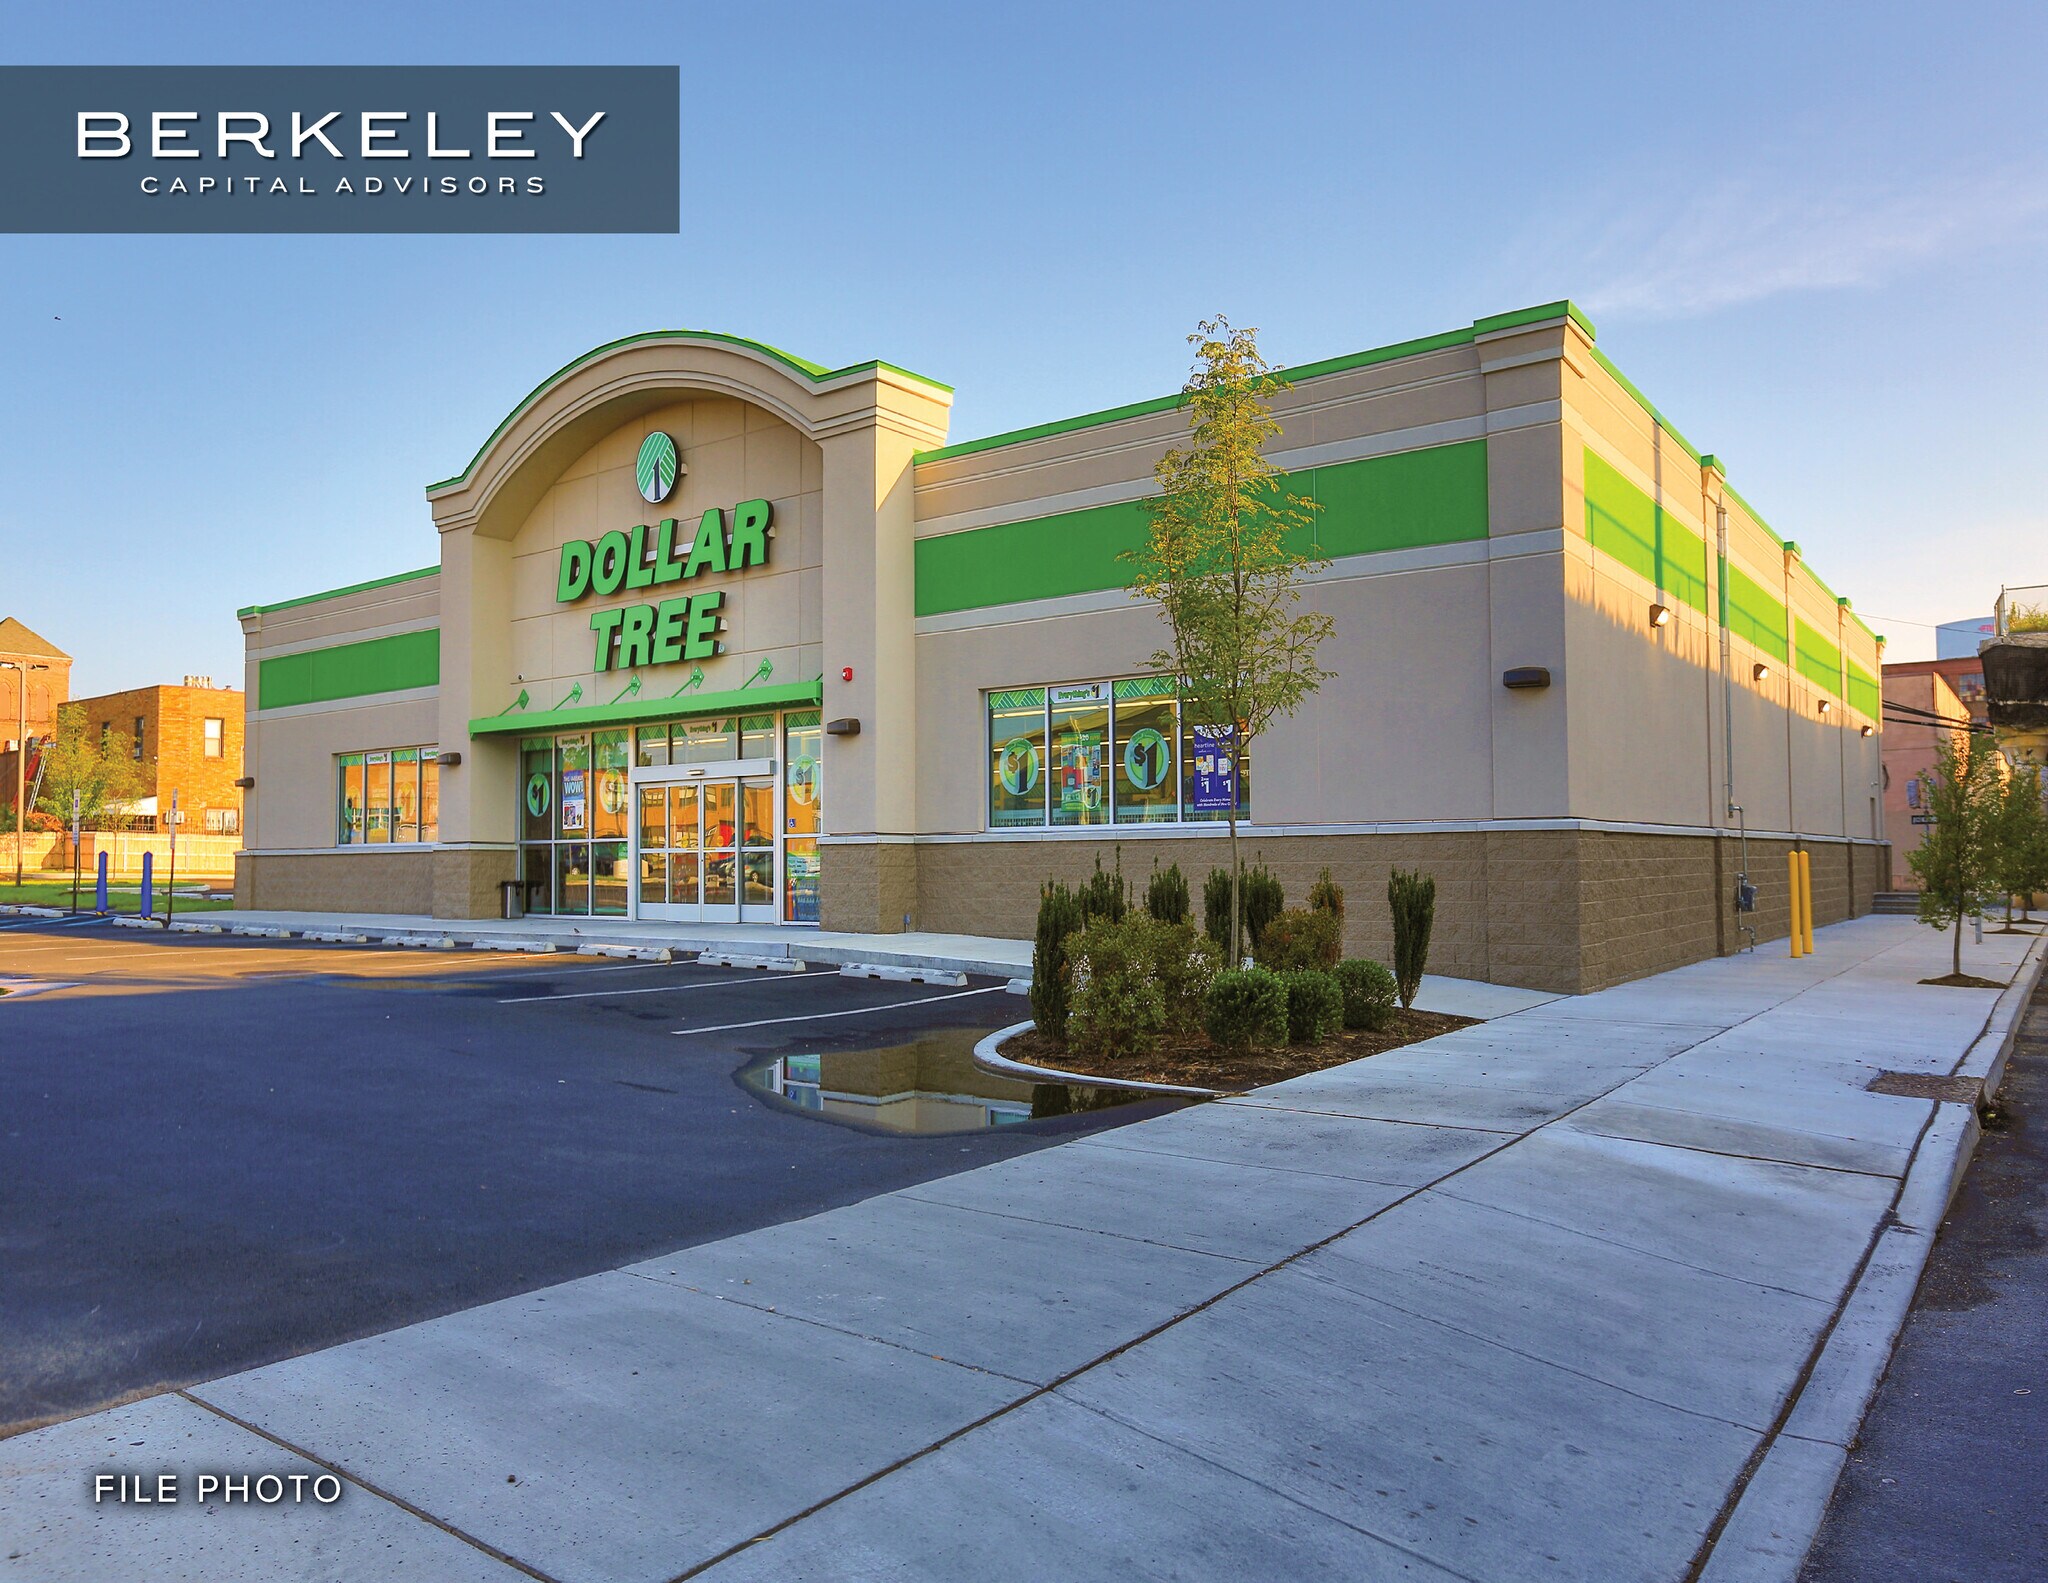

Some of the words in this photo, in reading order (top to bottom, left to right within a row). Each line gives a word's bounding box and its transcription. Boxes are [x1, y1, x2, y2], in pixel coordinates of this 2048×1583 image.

[556, 498, 774, 603] DOLLAR
[590, 591, 726, 672] TREE
[795, 765, 813, 804] $1
[1007, 749, 1029, 794] $1
[1133, 741, 1158, 788] $1
[532, 782, 545, 815] $1
[564, 781, 584, 794] WOW!
[1201, 780, 1209, 793] $1
